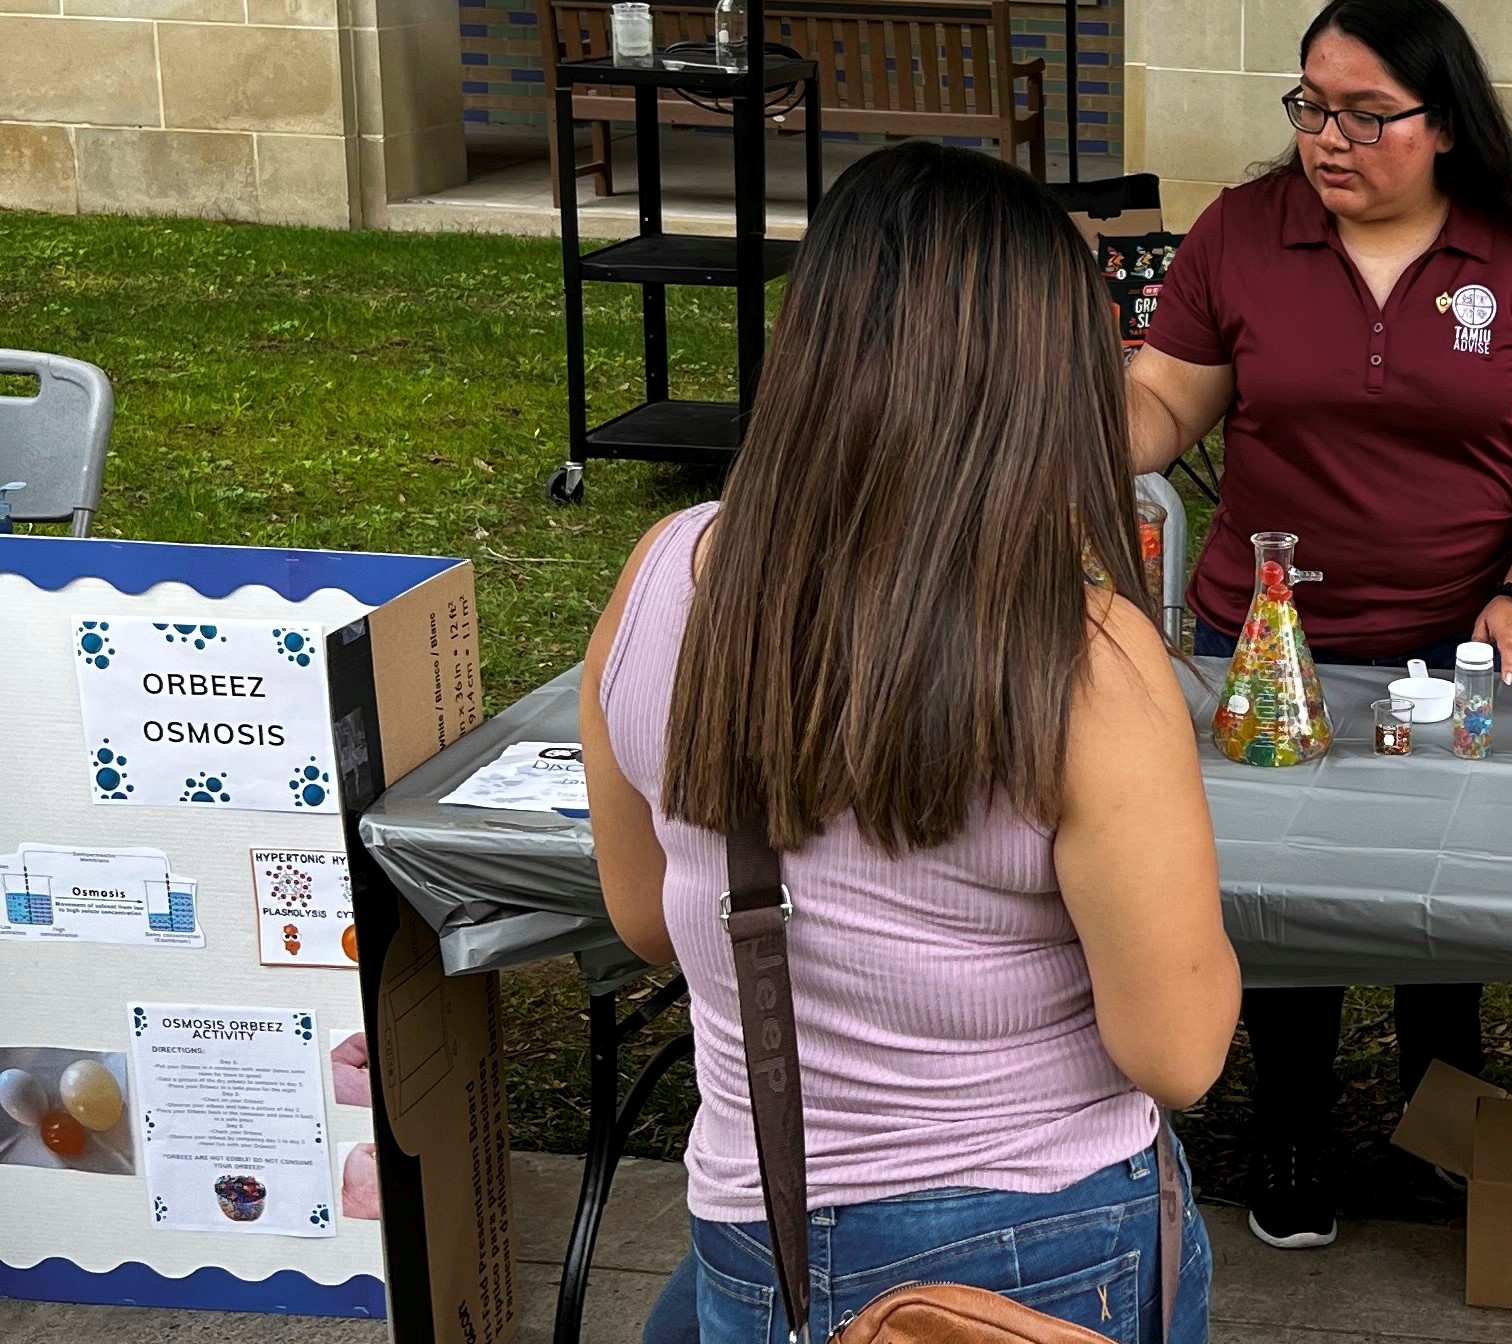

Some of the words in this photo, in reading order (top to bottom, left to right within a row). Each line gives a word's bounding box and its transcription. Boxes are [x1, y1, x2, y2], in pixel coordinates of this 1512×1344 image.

[1453, 339, 1490, 354] ADVISE
[1454, 326, 1491, 342] TAMIU
[429, 612, 438, 649] Blanc
[450, 621, 459, 640] 12
[142, 672, 266, 698] ORBEEZ
[434, 660, 443, 703] Blanco
[142, 719, 286, 747] OSMOSIS
[255, 852, 326, 864] HYPERTONIC
[72, 886, 126, 899] Osmosis
[262, 907, 327, 918] PLASMOLYSIS
[162, 1018, 225, 1030] OSMOSIS
[229, 1021, 284, 1033] ORBEEZ
[754, 936, 788, 1093] Jeep
[192, 1029, 256, 1041] ACTIVITY
[465, 1080, 478, 1144] Board
[479, 1057, 497, 1210] presentaciones
[472, 1145, 486, 1275] Presentation
[487, 1212, 499, 1258] para
[502, 1237, 514, 1324] Panneau
